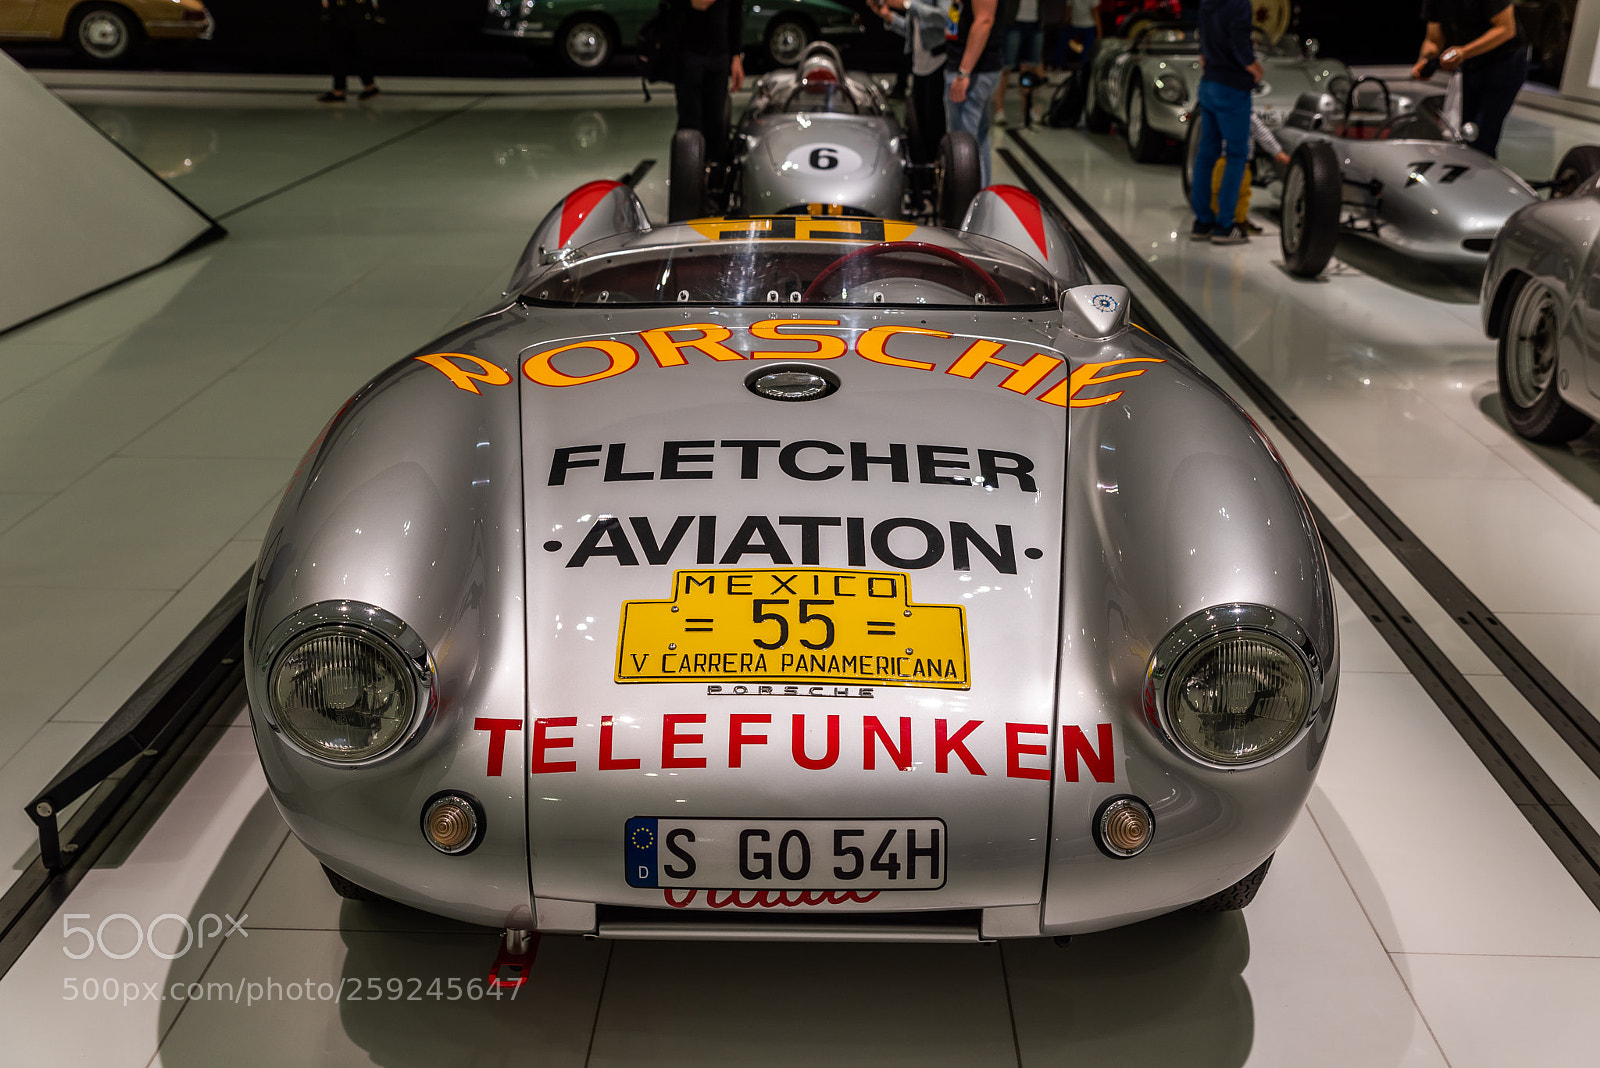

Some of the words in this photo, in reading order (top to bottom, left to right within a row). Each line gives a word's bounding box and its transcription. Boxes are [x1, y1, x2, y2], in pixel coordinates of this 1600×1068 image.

[809, 147, 839, 170] 6
[414, 318, 1166, 408] PORSCHE
[547, 440, 1038, 493] FLETCHER
[685, 574, 898, 598] MEXICO
[752, 599, 836, 650] 55
[630, 653, 650, 673] V
[661, 653, 768, 674] CARRERA
[781, 653, 958, 680] PANAMERICANA
[707, 685, 875, 698] PORSCHE
[474, 713, 1116, 783] TELEFUNKEN
[638, 865, 650, 879] D
[663, 828, 697, 880] S
[739, 828, 811, 881] GO
[833, 828, 941, 881] 54H
